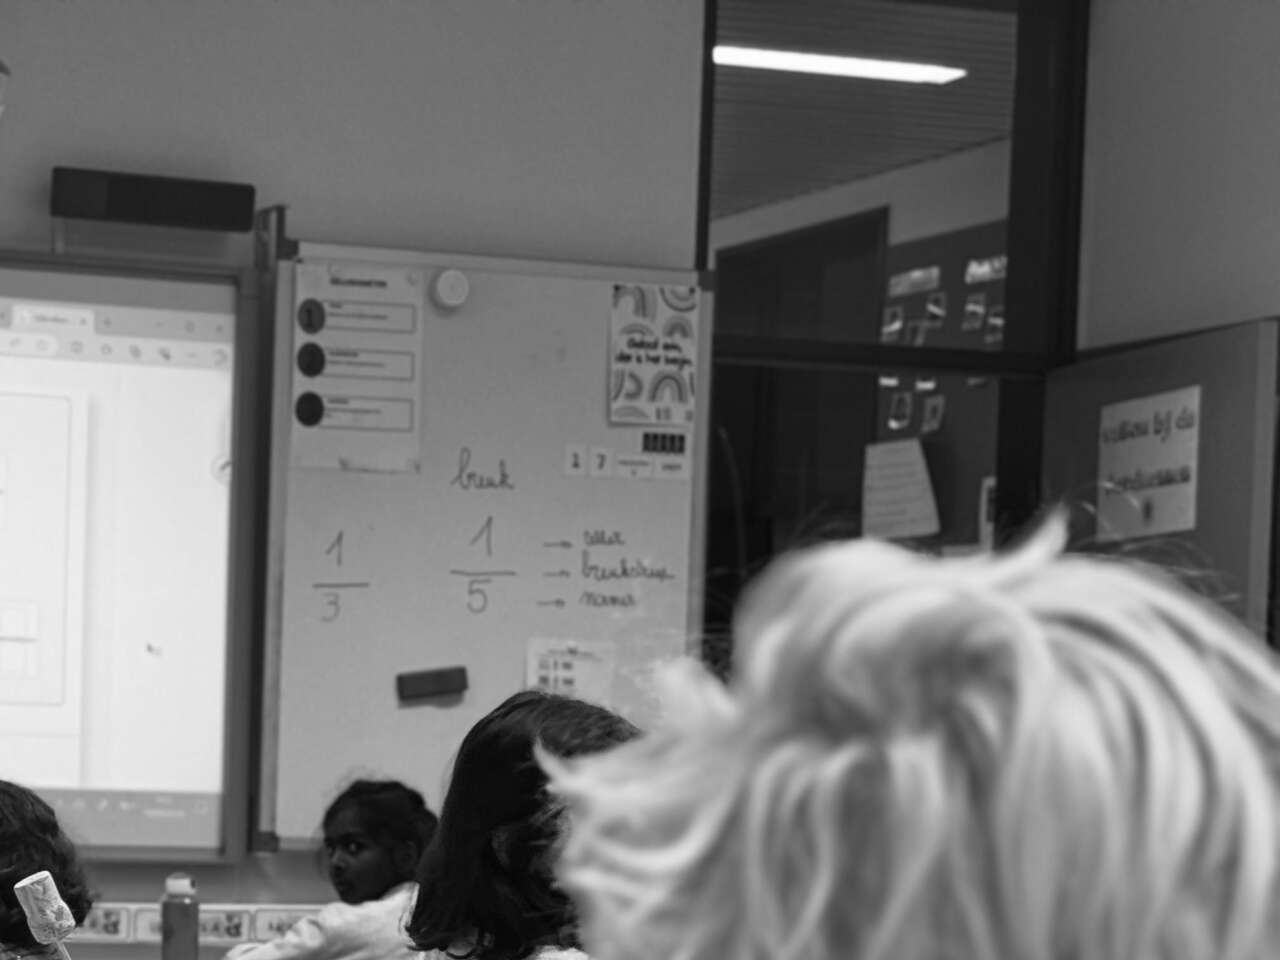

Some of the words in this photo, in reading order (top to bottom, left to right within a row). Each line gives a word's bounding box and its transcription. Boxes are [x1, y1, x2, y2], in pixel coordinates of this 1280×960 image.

[324, 529, 345, 567] 1
[468, 515, 494, 559] 1
[320, 591, 342, 623] 3
[466, 578, 494, 615] 5
